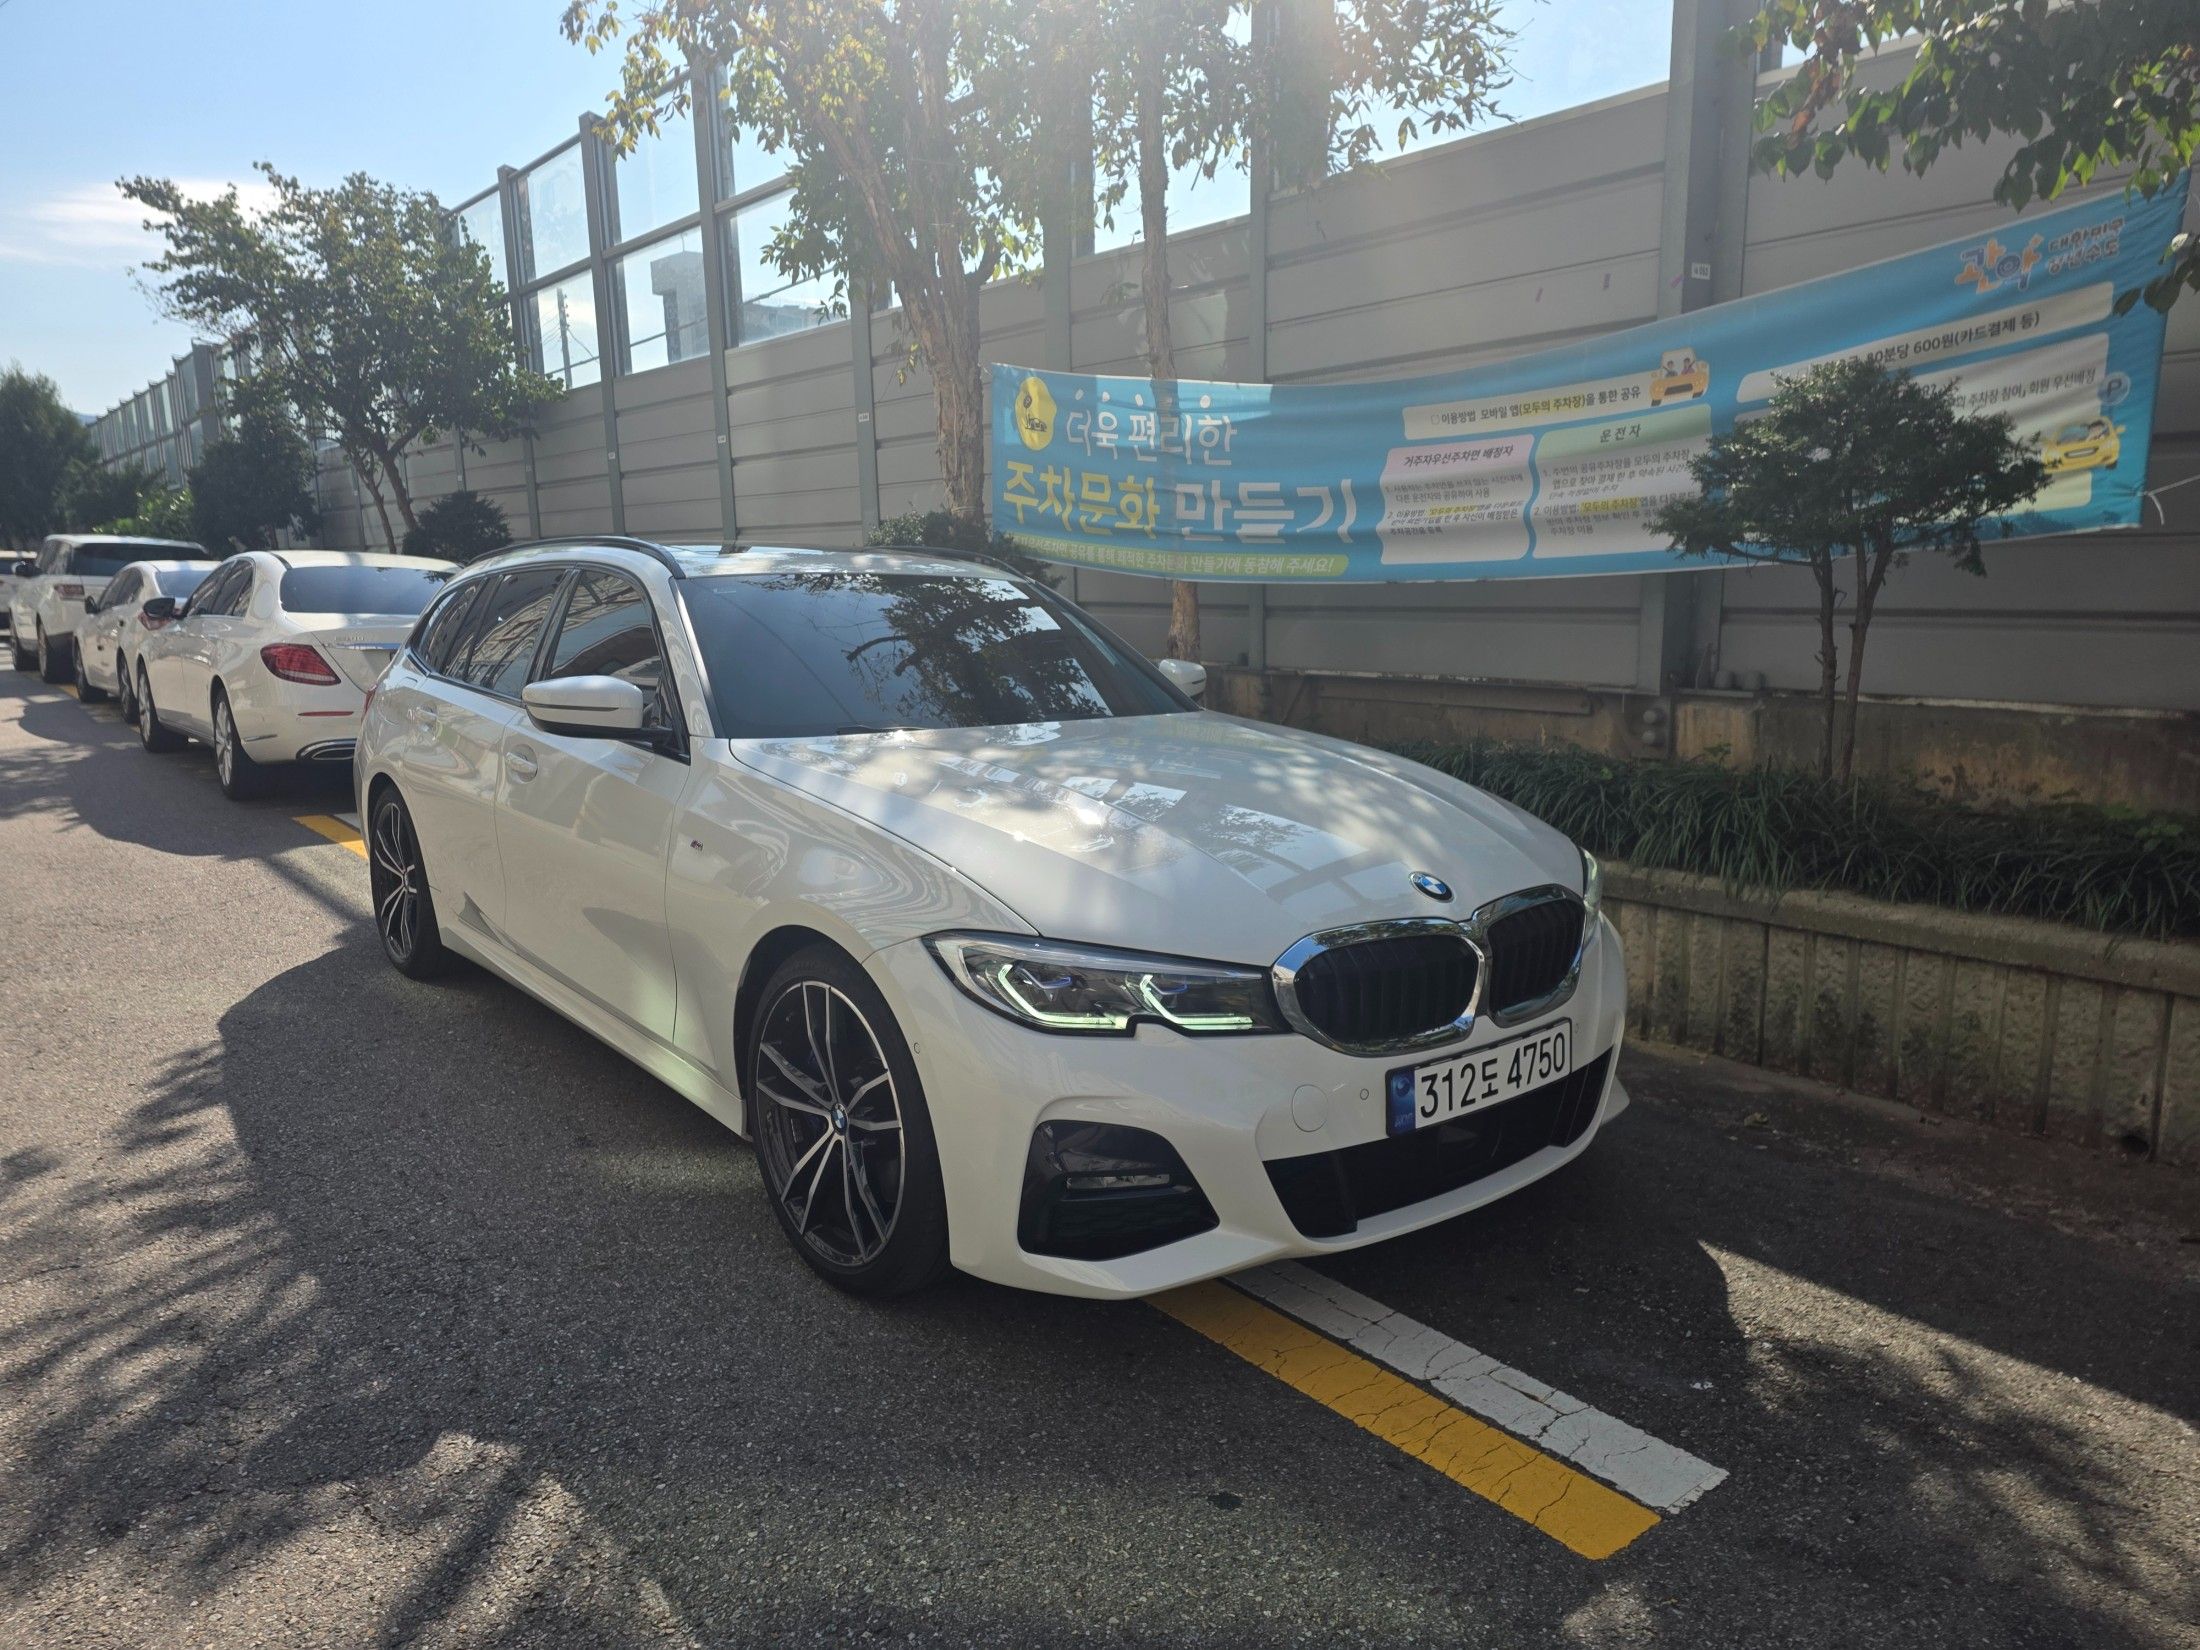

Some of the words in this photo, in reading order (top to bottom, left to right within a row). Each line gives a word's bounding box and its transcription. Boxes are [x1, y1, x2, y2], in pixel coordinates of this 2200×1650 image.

[2020, 311, 2041, 330] 등)
[2106, 378, 2123, 399] P
[1441, 408, 1476, 425] 이용방법
[1480, 405, 1507, 420] 모바일
[1553, 393, 1595, 410] 주차장)을
[1598, 390, 1618, 404] 통한
[1620, 386, 1641, 401] 공유
[1066, 410, 1118, 461] 더욱
[1127, 411, 1237, 466] 편리한
[1403, 449, 1481, 468] 거주자우선주차면
[1483, 445, 1514, 458] 배정자
[1634, 453, 1661, 466] 모두의
[1003, 460, 1160, 541] 주차문화
[1175, 478, 1357, 543] 만들기
[1190, 553, 1241, 574] 만들기에
[1243, 555, 1283, 575] 동참해
[1286, 556, 1334, 575] 주세요!
[1419, 1057, 1499, 1119] 312도
[1506, 1031, 1566, 1088] 4750
